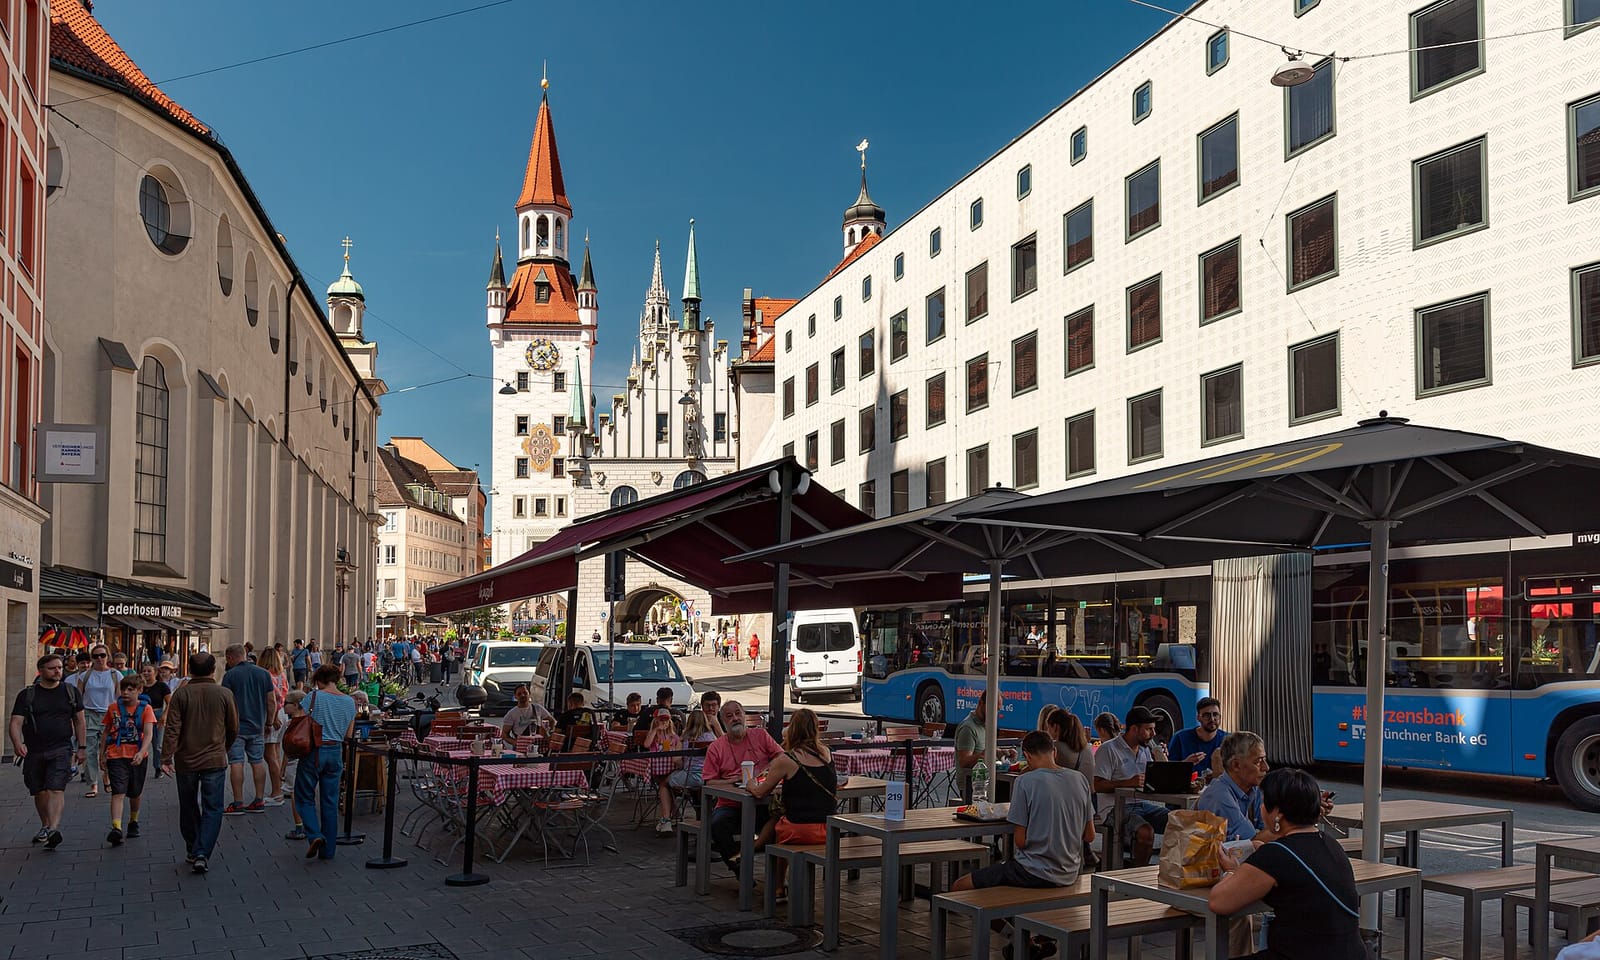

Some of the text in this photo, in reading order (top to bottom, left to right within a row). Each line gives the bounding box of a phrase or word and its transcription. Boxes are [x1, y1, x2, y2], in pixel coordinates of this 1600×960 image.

[1577, 534, 1600, 544] mvg
[102, 602, 160, 616] Lederhosen
[1380, 728, 1487, 746] ünchner Bank eG
[887, 793, 903, 801] 219
